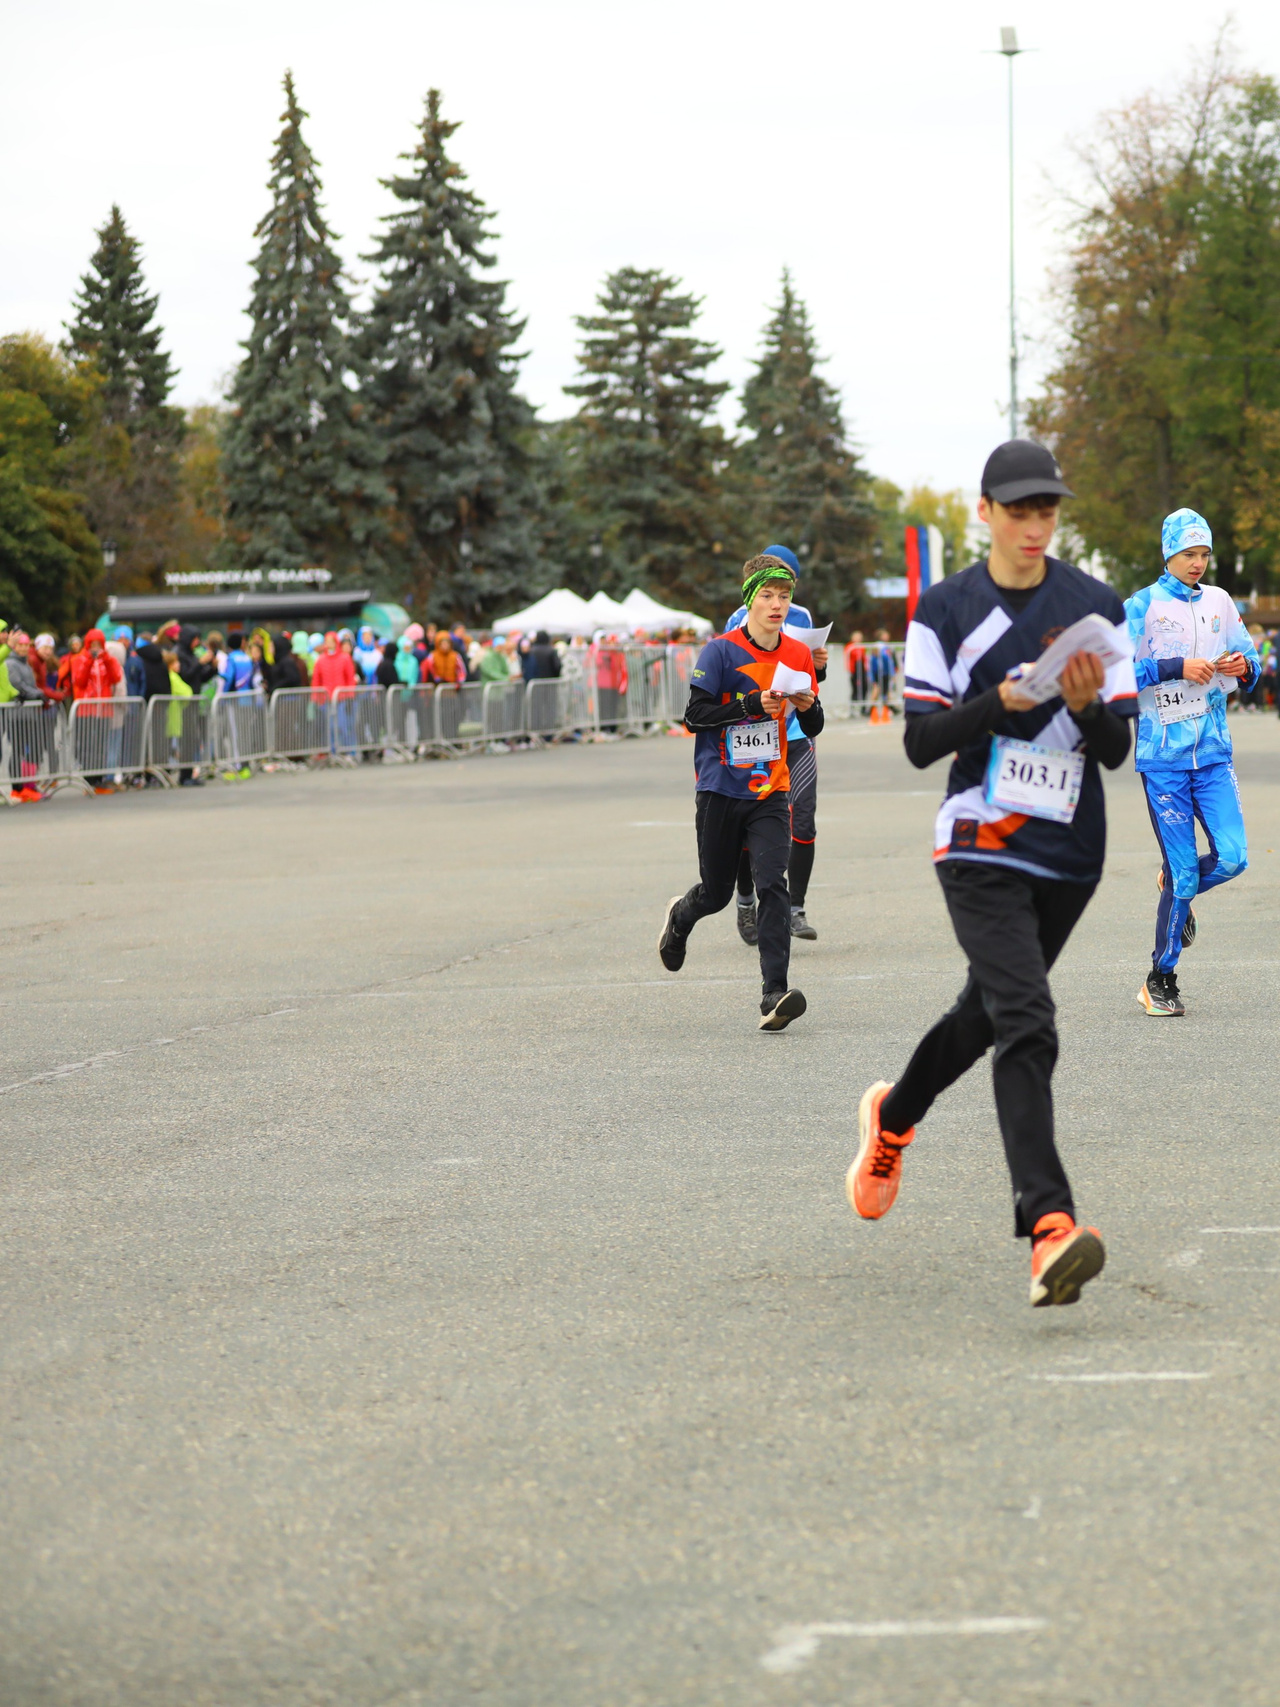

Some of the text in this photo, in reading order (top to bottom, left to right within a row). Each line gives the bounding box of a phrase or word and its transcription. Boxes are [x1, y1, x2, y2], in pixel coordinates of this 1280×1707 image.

[268, 569, 332, 583] ОБЛАСТЬ
[733, 732, 771, 748] 346.1
[1002, 759, 1067, 790] 303.1
